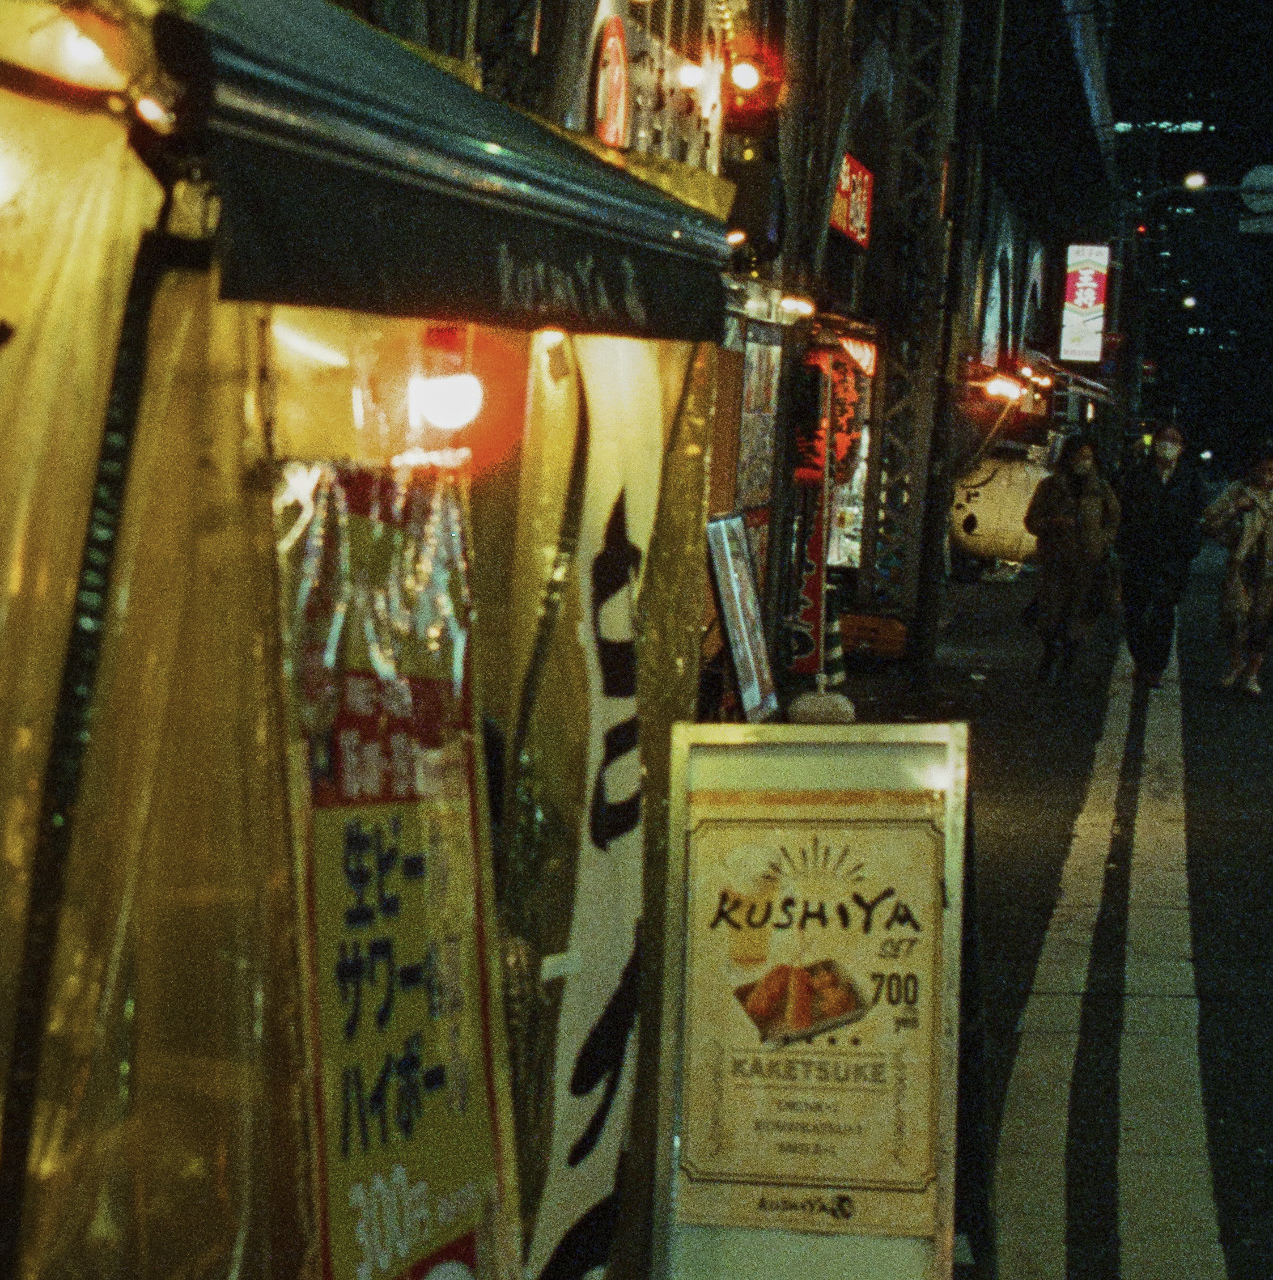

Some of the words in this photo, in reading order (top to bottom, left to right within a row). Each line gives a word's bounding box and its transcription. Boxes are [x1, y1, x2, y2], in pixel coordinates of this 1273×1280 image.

[1074, 268, 1098, 308] 王将
[710, 887, 922, 934] KUSHIYA
[871, 972, 919, 1006] 700
[731, 1057, 887, 1085] KAKETSUKE
